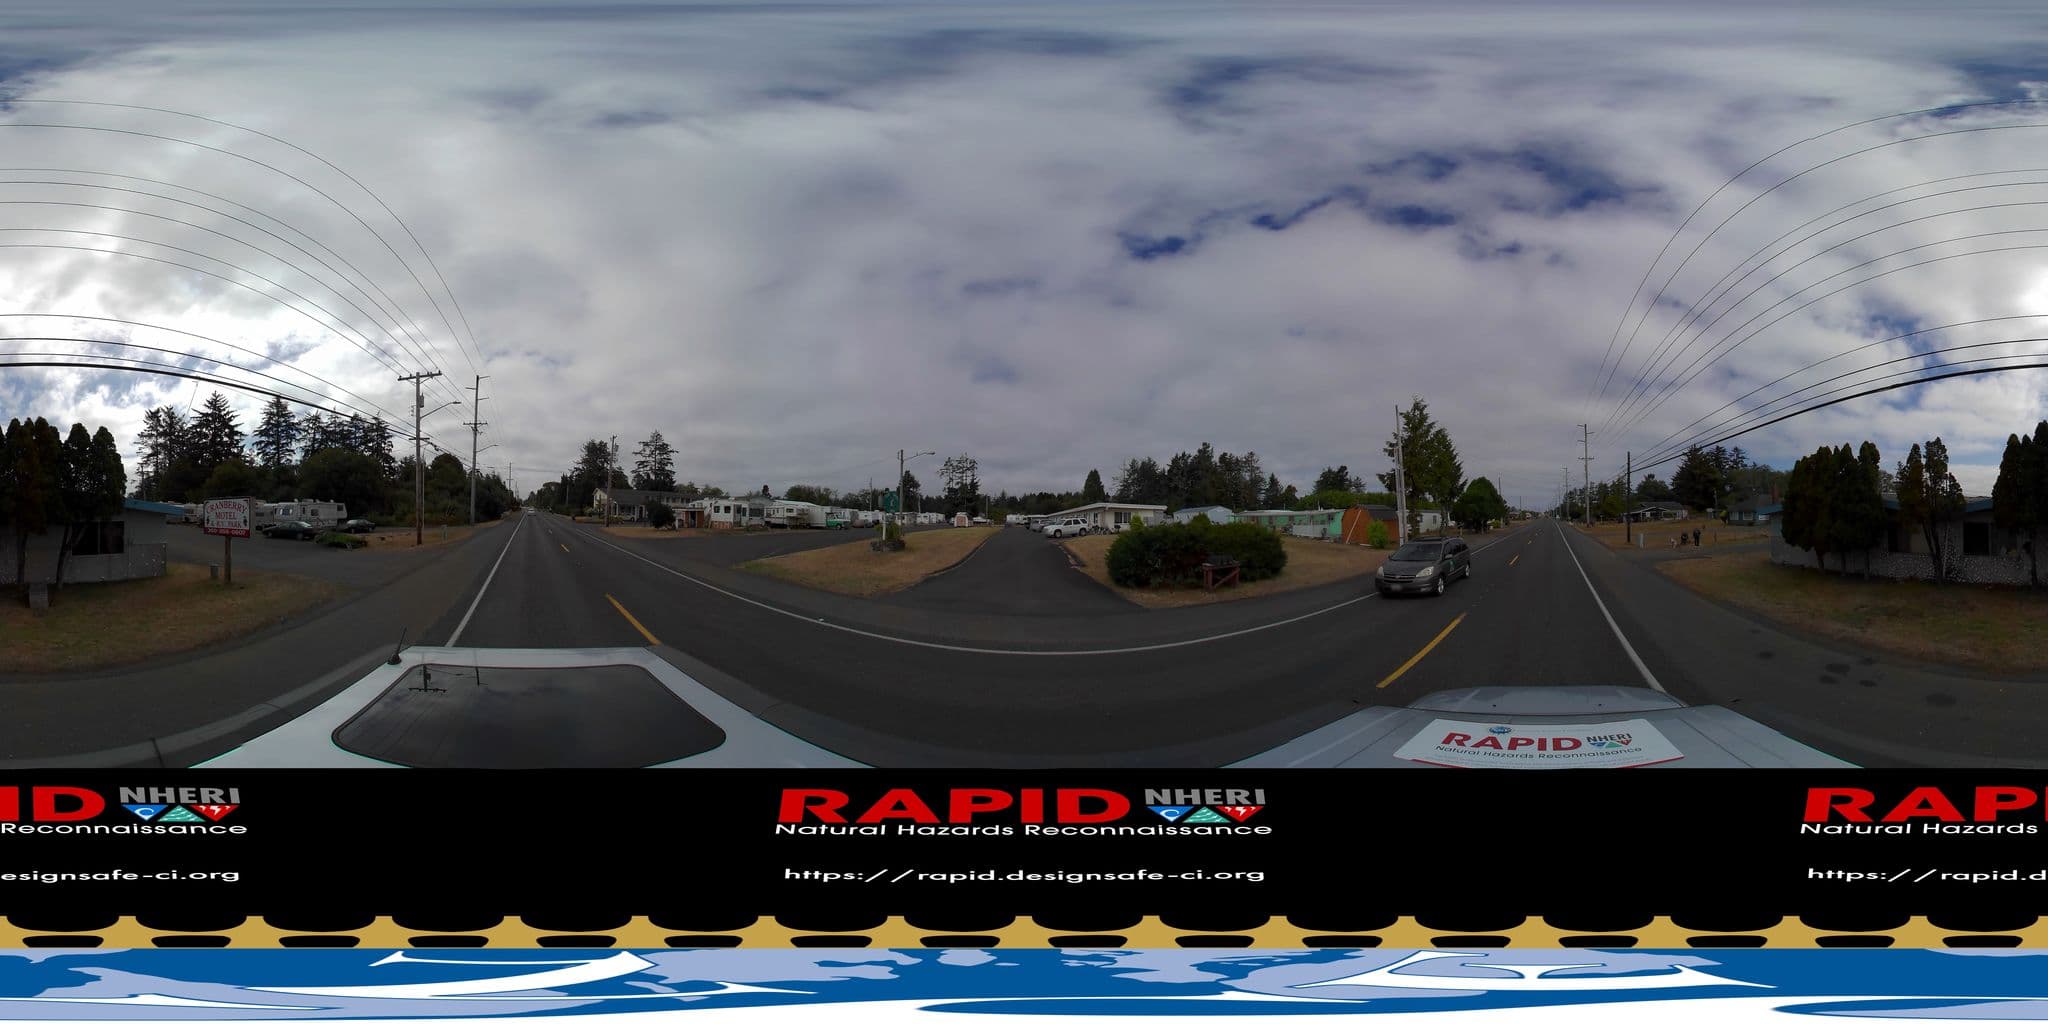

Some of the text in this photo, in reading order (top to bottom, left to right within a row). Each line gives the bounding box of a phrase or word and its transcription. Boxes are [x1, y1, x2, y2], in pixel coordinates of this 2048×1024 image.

[207, 501, 247, 514] CRANBERRY
[215, 511, 237, 520] MOTEL
[1441, 732, 1582, 751] RAPID
[1586, 733, 1632, 743] NHERI
[1436, 745, 1642, 759] Natural Hazards Reconnaissance
